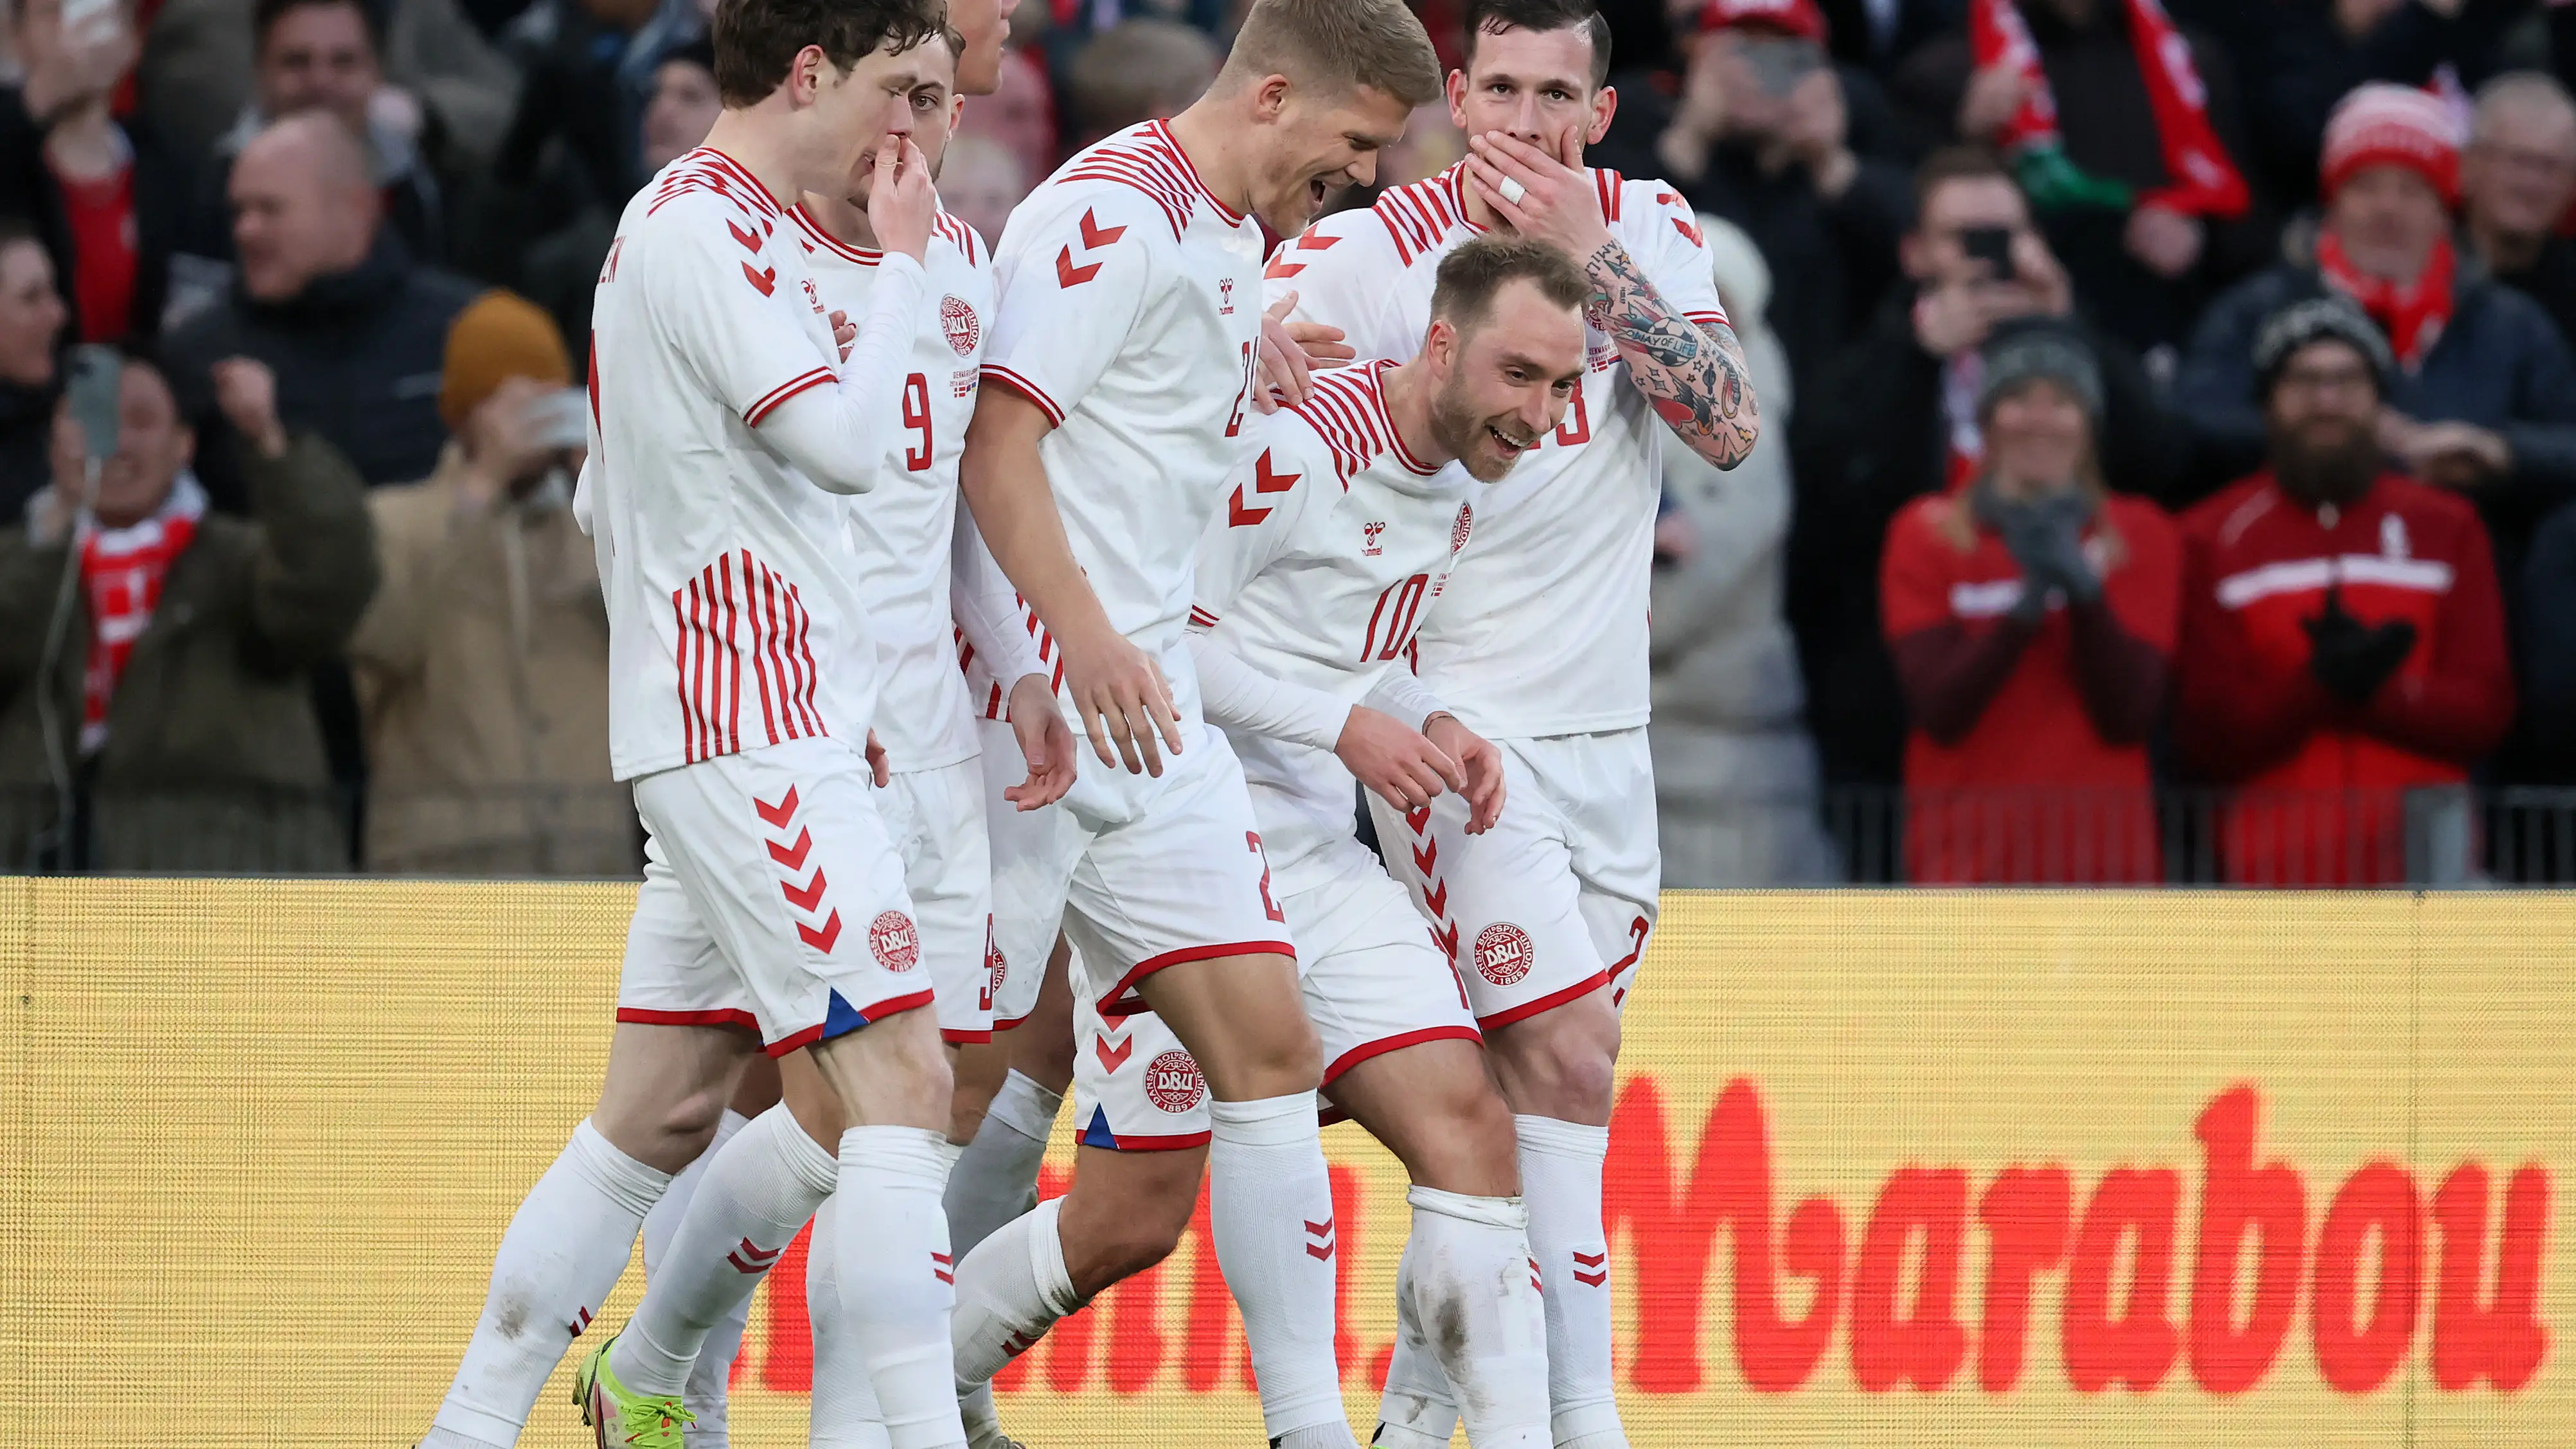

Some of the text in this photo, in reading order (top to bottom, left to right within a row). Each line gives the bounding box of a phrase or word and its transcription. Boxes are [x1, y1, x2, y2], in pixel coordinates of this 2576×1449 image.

[1673, 340, 1696, 357] LIFE
[902, 372, 933, 472] 9
[1359, 573, 1429, 662] 10
[879, 929, 911, 954] DBU
[1484, 940, 1522, 968] DBU
[1520, 934, 1532, 970] UNION
[1475, 948, 1496, 982] DANSK
[1500, 971, 1524, 985] 1889
[1146, 1067, 1161, 1105] DANSK
[1157, 1071, 1194, 1091] DBU
[1188, 1071, 1205, 1106] UNION
[1162, 1103, 1189, 1113] 1889
[1604, 1073, 2551, 1396] Marabou
